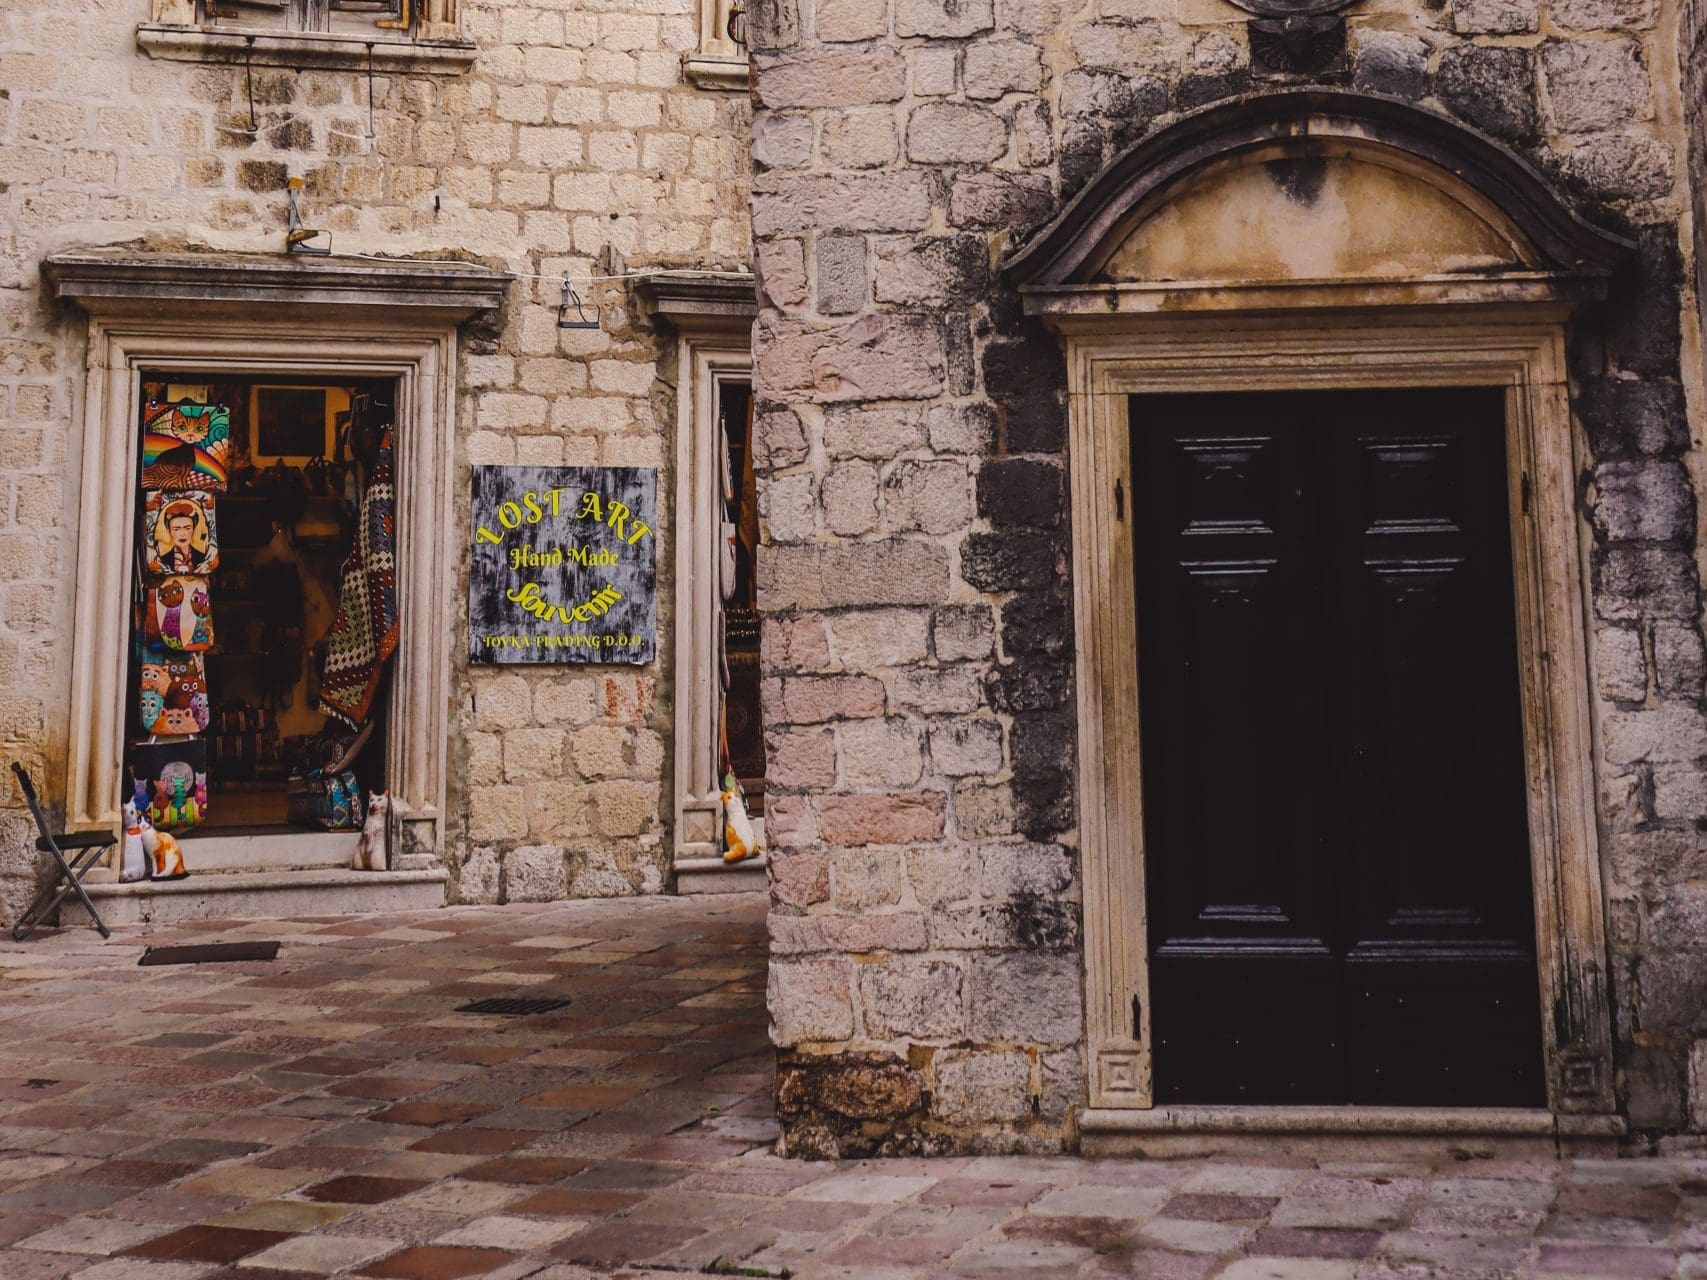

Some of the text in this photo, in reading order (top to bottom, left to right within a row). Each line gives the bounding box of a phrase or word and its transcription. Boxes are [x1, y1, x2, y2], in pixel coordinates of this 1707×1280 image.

[475, 488, 653, 545] LOST ART
[510, 545, 620, 570] Hand Made
[506, 582, 622, 624] Souvenir
[603, 635, 645, 647] D.O.O.
